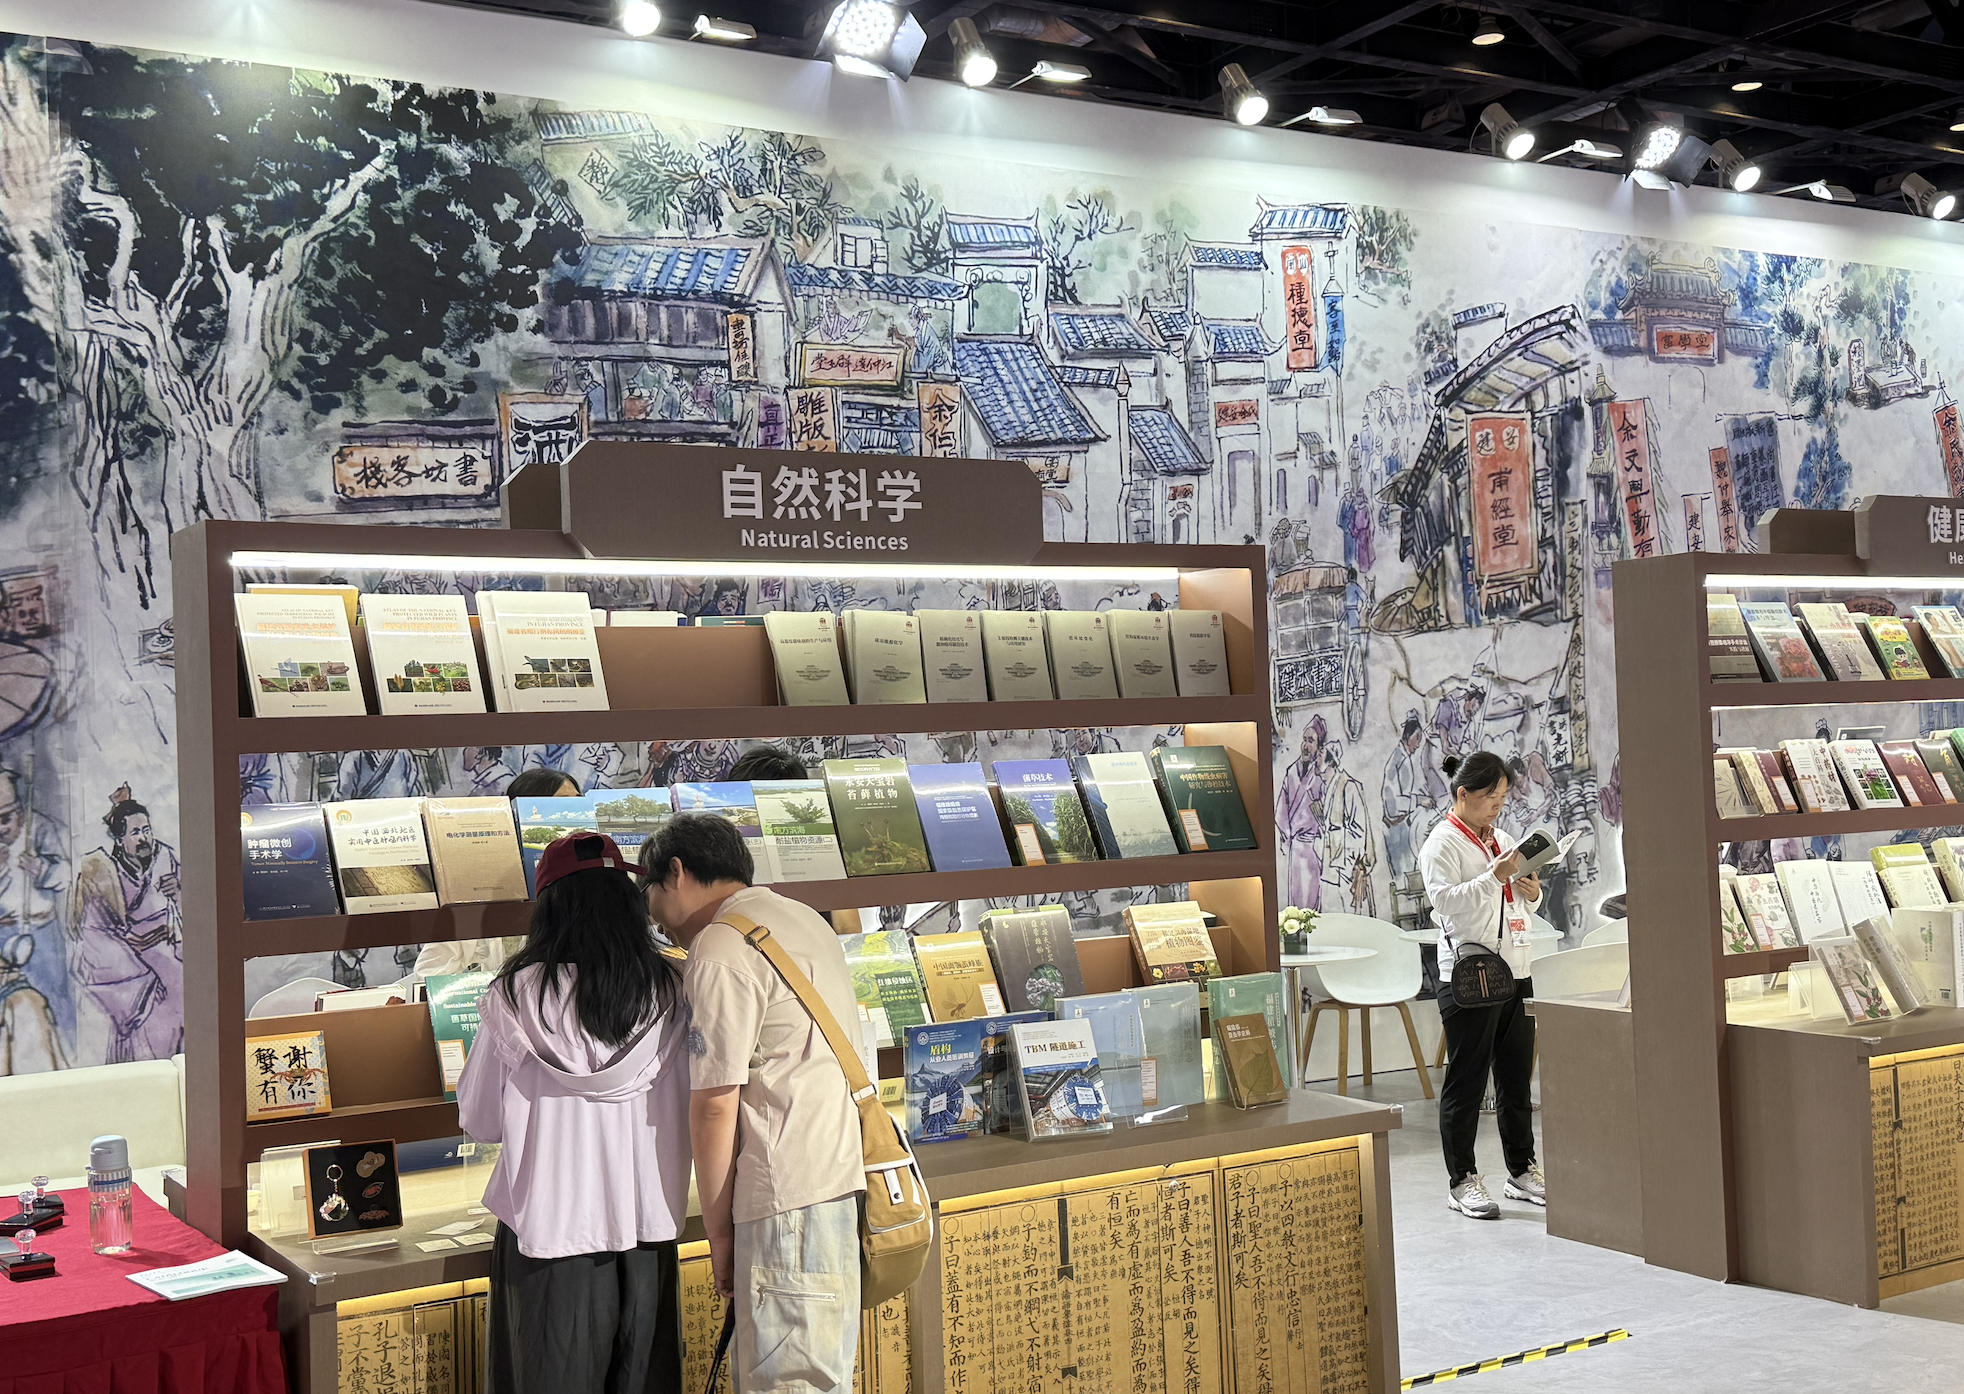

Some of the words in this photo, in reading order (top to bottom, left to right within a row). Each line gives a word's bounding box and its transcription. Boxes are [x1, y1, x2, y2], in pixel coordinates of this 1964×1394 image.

[722, 464, 923, 523] 自然科学
[741, 529, 819, 549] Natural
[823, 530, 909, 551] Sciences
[249, 849, 282, 860] 手术学
[1025, 1044, 1047, 1053] TBM
